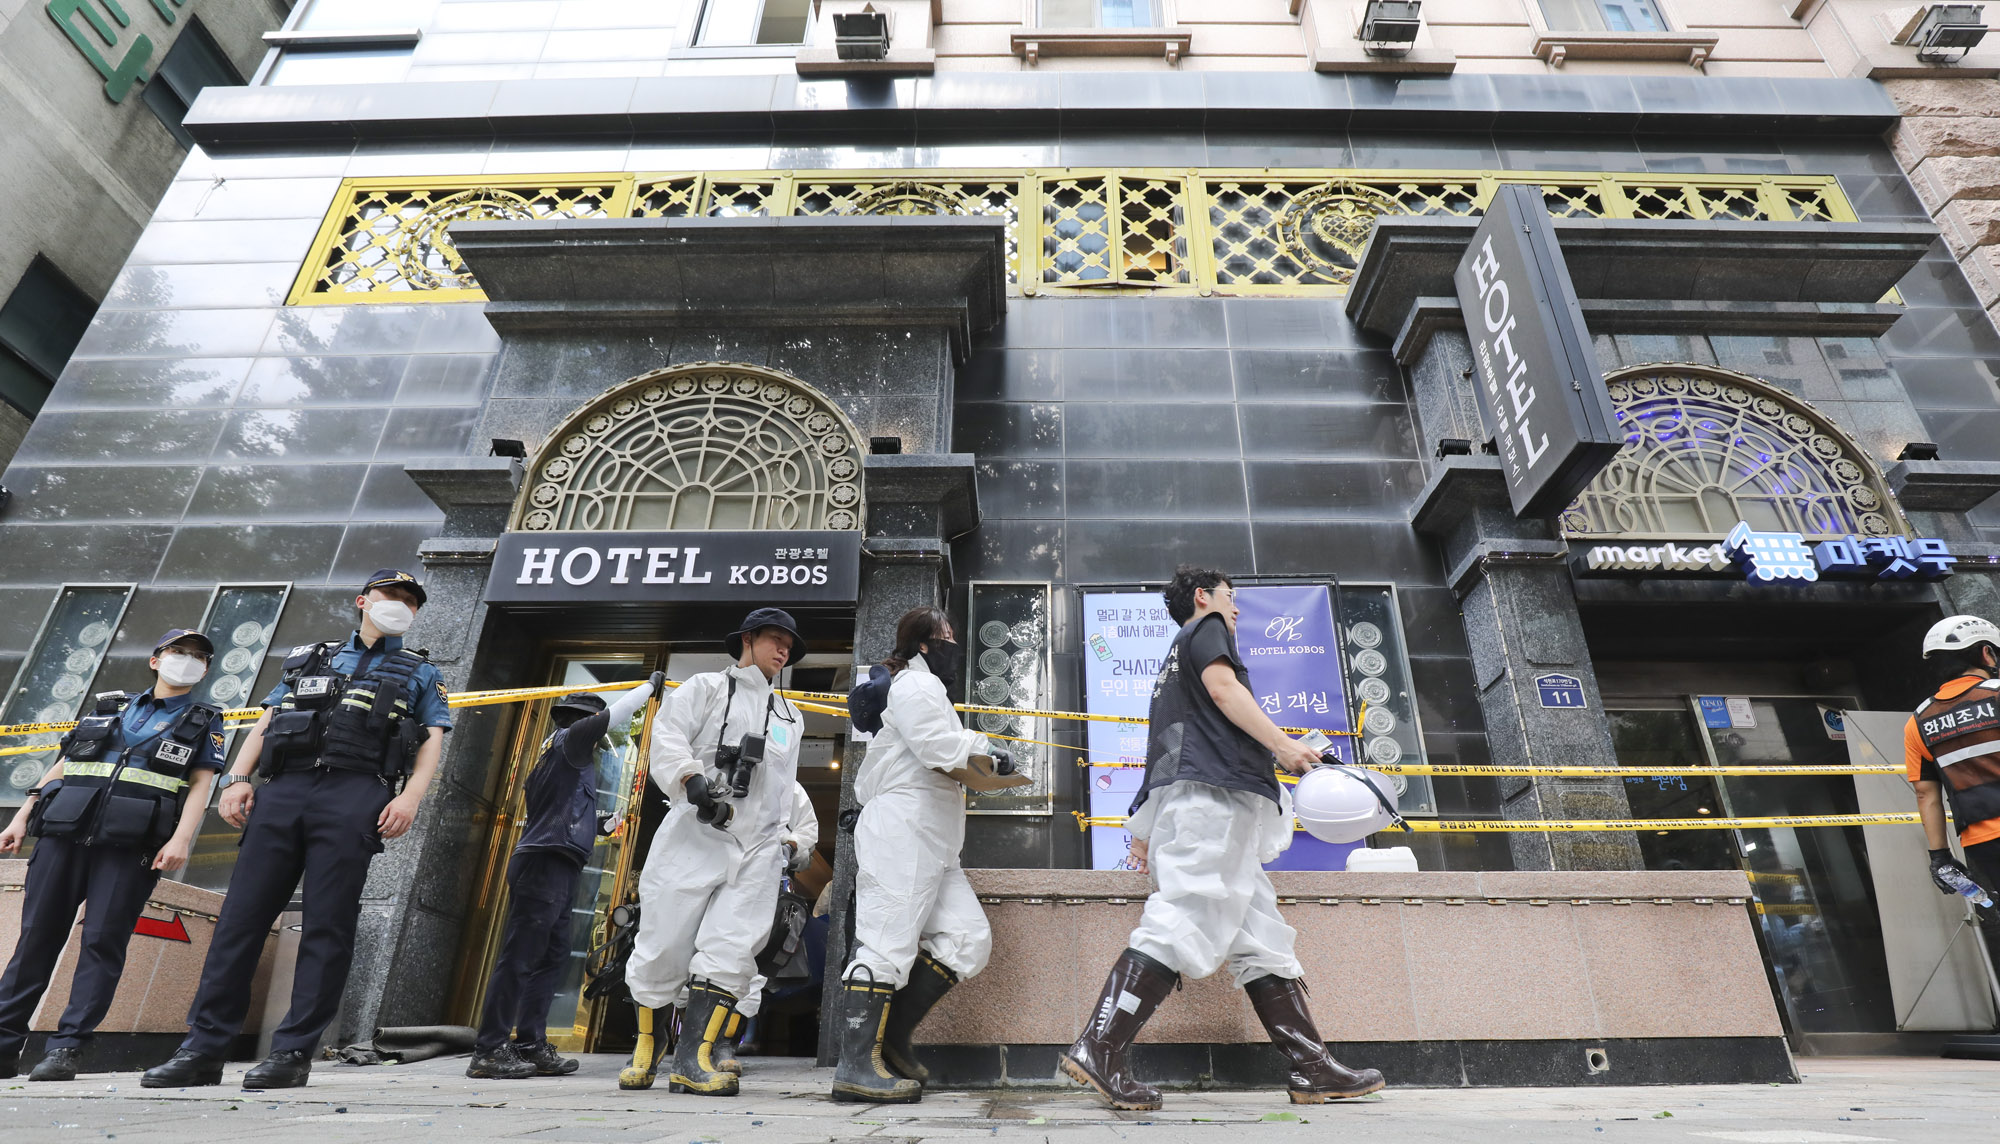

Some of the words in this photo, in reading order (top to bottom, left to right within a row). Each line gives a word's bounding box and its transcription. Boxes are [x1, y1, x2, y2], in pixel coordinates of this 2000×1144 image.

[1471, 233, 1550, 471] HOTEL
[774, 547, 829, 561] 관광호텔
[1592, 543, 1732, 568] market
[516, 546, 712, 586] HOTEL
[728, 565, 829, 585] KOBOS
[1096, 608, 1119, 623] 멀리
[1122, 608, 1132, 622] 갈
[1136, 608, 1147, 622] 것
[1101, 625, 1140, 639] 1층에서
[1142, 625, 1169, 638] 해결!
[1249, 646, 1287, 656] HOTEL
[1288, 645, 1326, 655] KOBOS
[1112, 658, 1163, 676] 24시간
[1100, 679, 1129, 697] 무인
[1260, 691, 1283, 715] 전
[1287, 691, 1331, 714] 객실
[1552, 691, 1571, 704] 11
[1923, 702, 1995, 736] 화재조사
[159, 752, 185, 763] POLICE
[64, 761, 109, 776] OLICE
[127, 768, 179, 790] POLIC
[1096, 996, 1114, 1032] SAFETY
